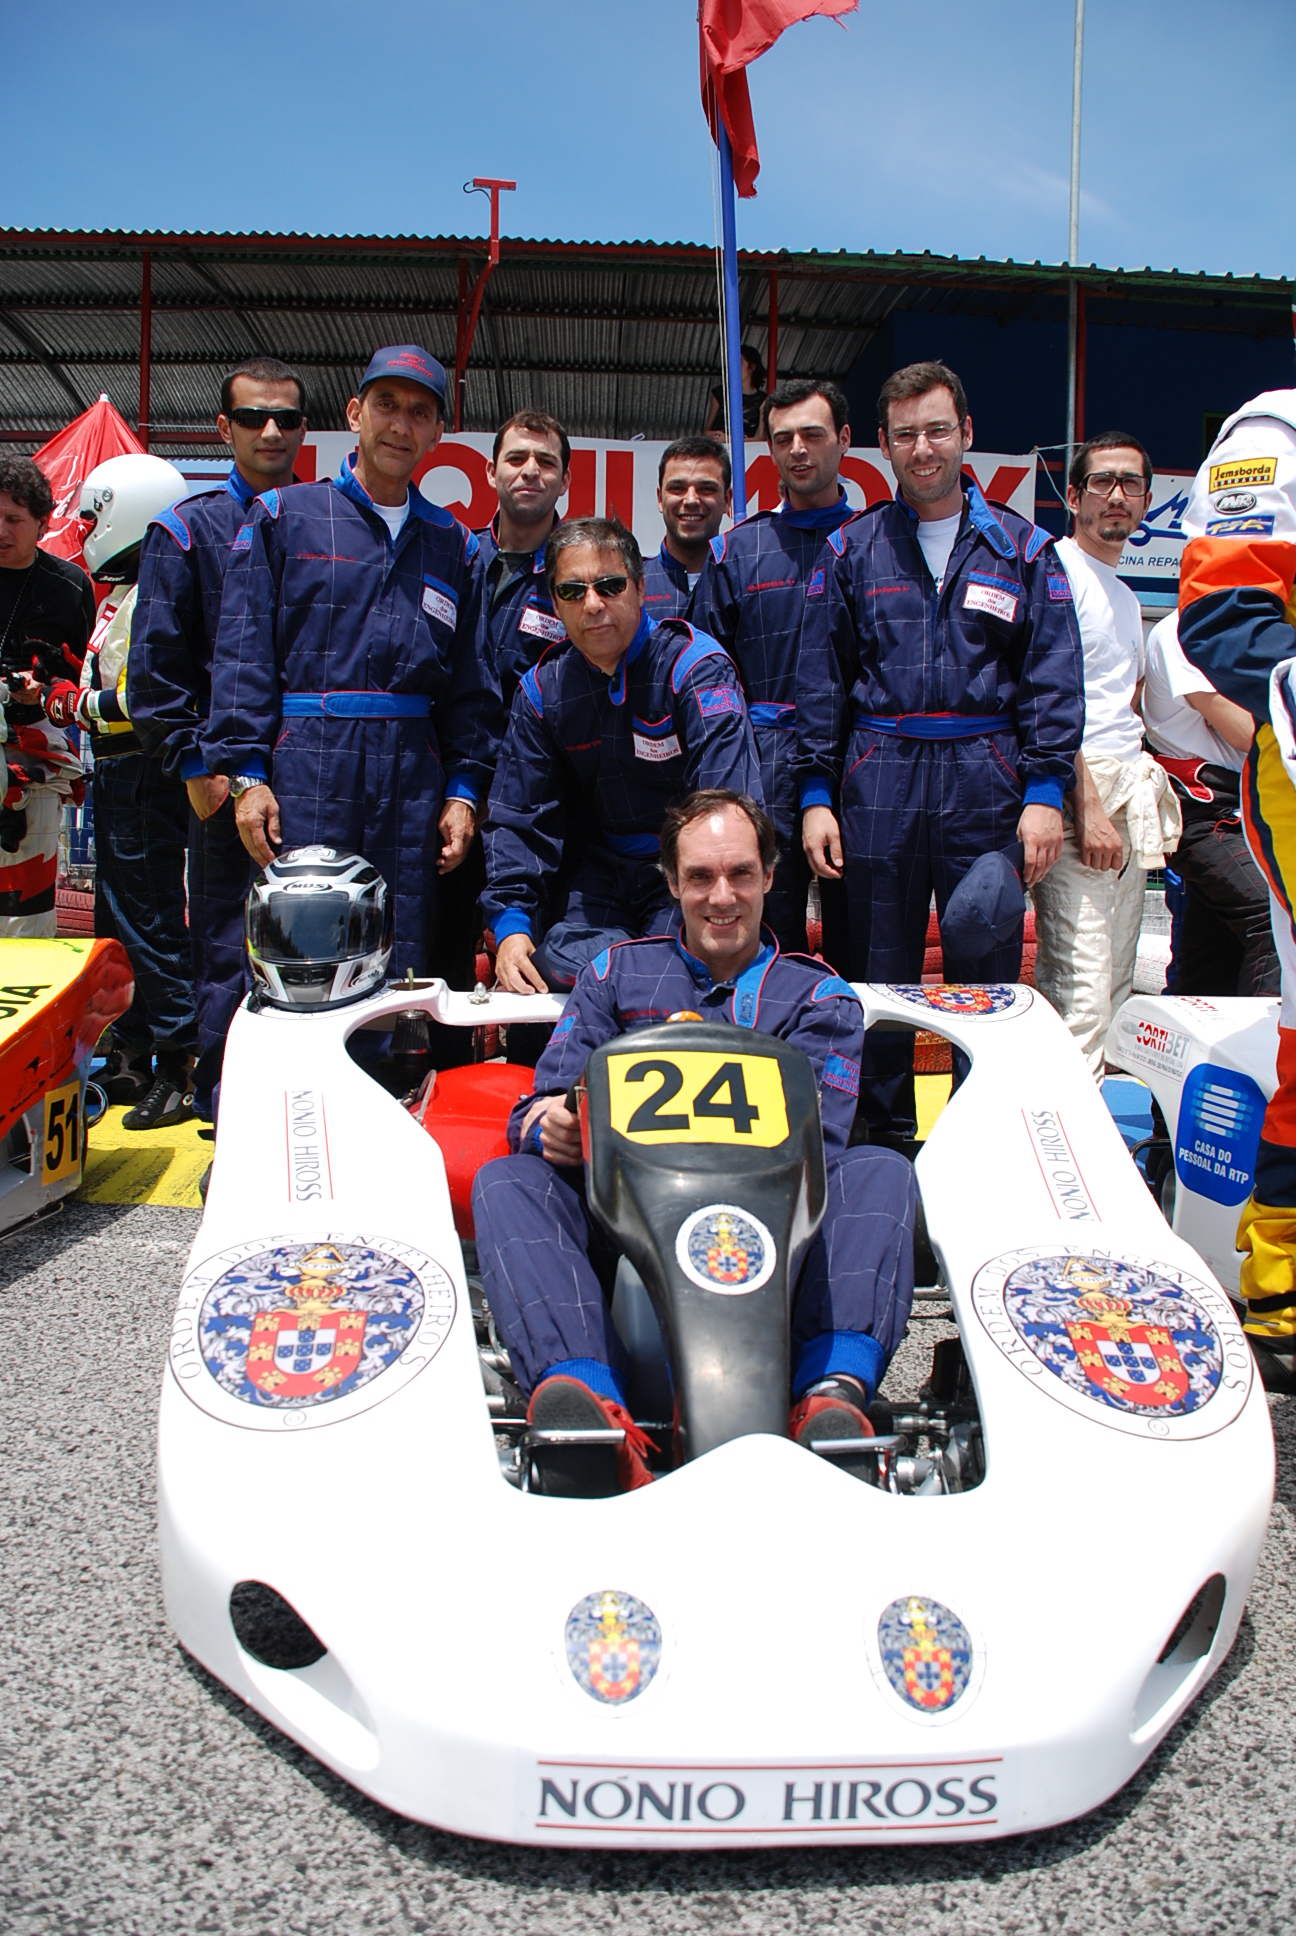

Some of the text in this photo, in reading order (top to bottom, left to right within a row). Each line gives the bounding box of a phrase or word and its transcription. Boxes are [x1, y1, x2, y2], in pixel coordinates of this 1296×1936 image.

[1148, 557, 1181, 567] REPA
[981, 590, 1005, 602] ORDEM
[624, 1059, 760, 1134] 24
[45, 1092, 79, 1171] 51
[1031, 1110, 1070, 1162] HIROSS
[1194, 1140, 1232, 1164] CASA DO
[294, 1145, 322, 1201] HIROSS
[1178, 1147, 1250, 1185] PESSOAL DA RTP
[172, 1232, 452, 1380] ORDEM DOS ENGENHEIROS
[977, 1246, 1249, 1393] ORDEM DOS ENGENHEIROS
[539, 1774, 998, 1822] NÓNIO HIROSS
